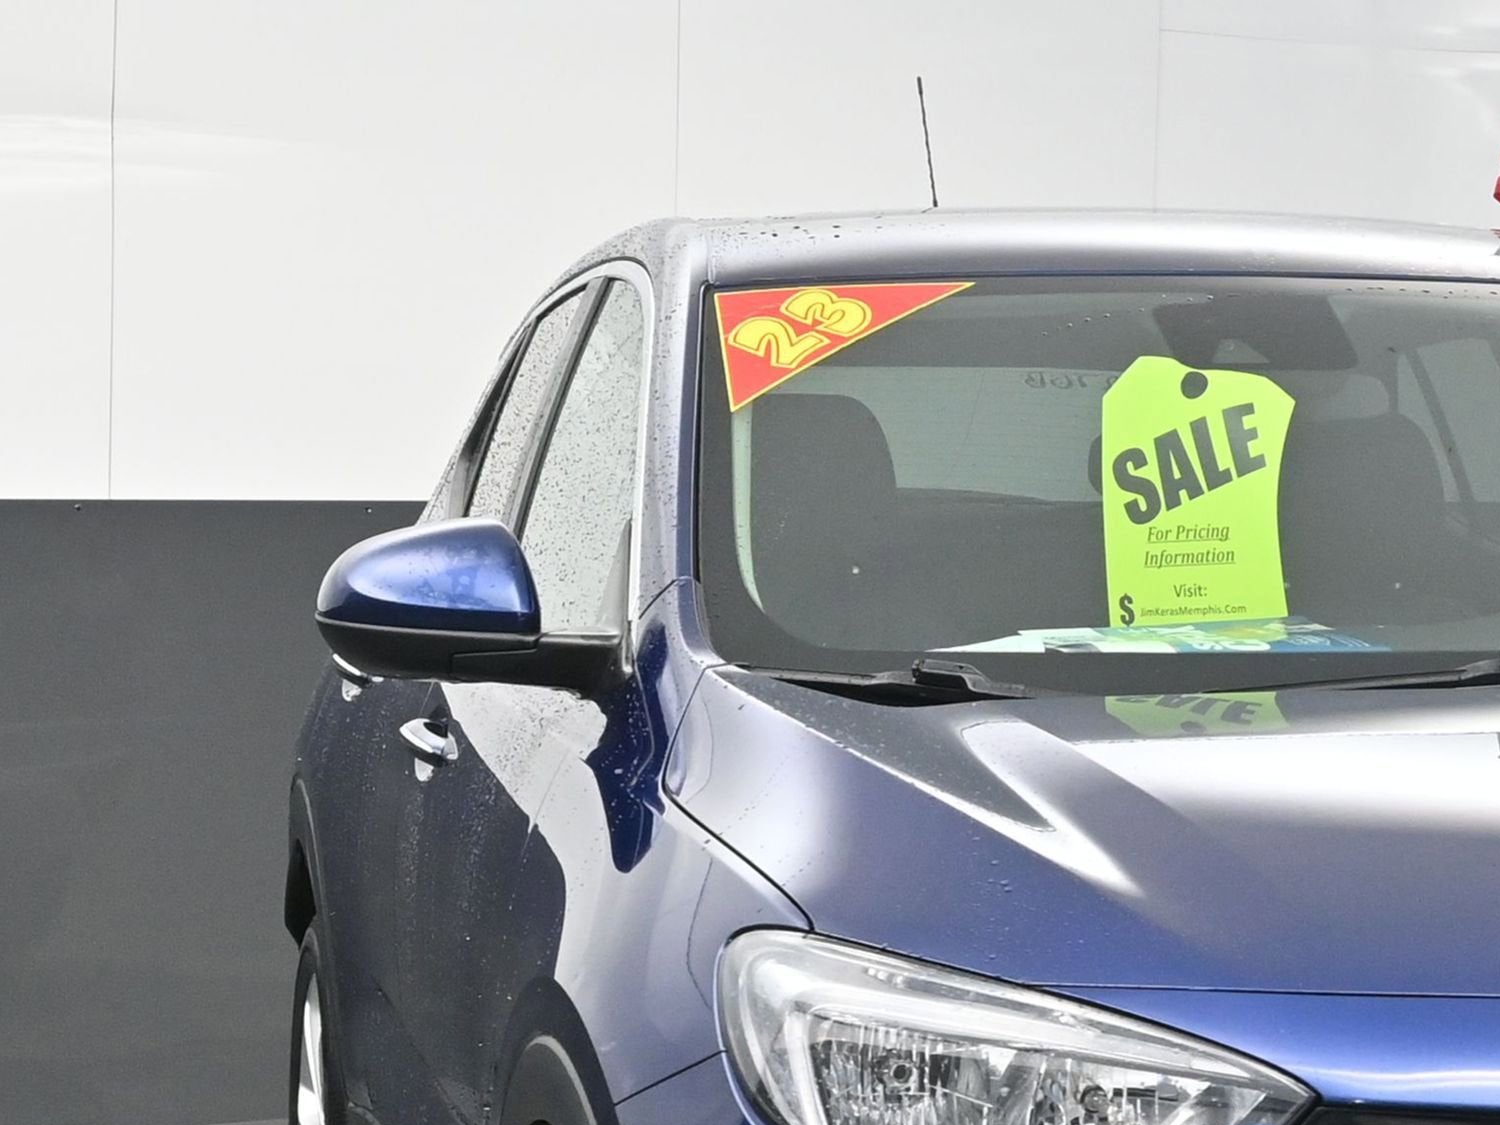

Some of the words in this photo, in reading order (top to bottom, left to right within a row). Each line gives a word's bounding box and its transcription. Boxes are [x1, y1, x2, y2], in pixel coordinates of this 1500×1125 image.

[728, 288, 873, 368] 23
[1112, 402, 1266, 525] SALE
[1147, 526, 1172, 542] For
[1175, 524, 1230, 542] Pricing
[1144, 548, 1235, 568] Information
[1173, 583, 1208, 598] Visit:
